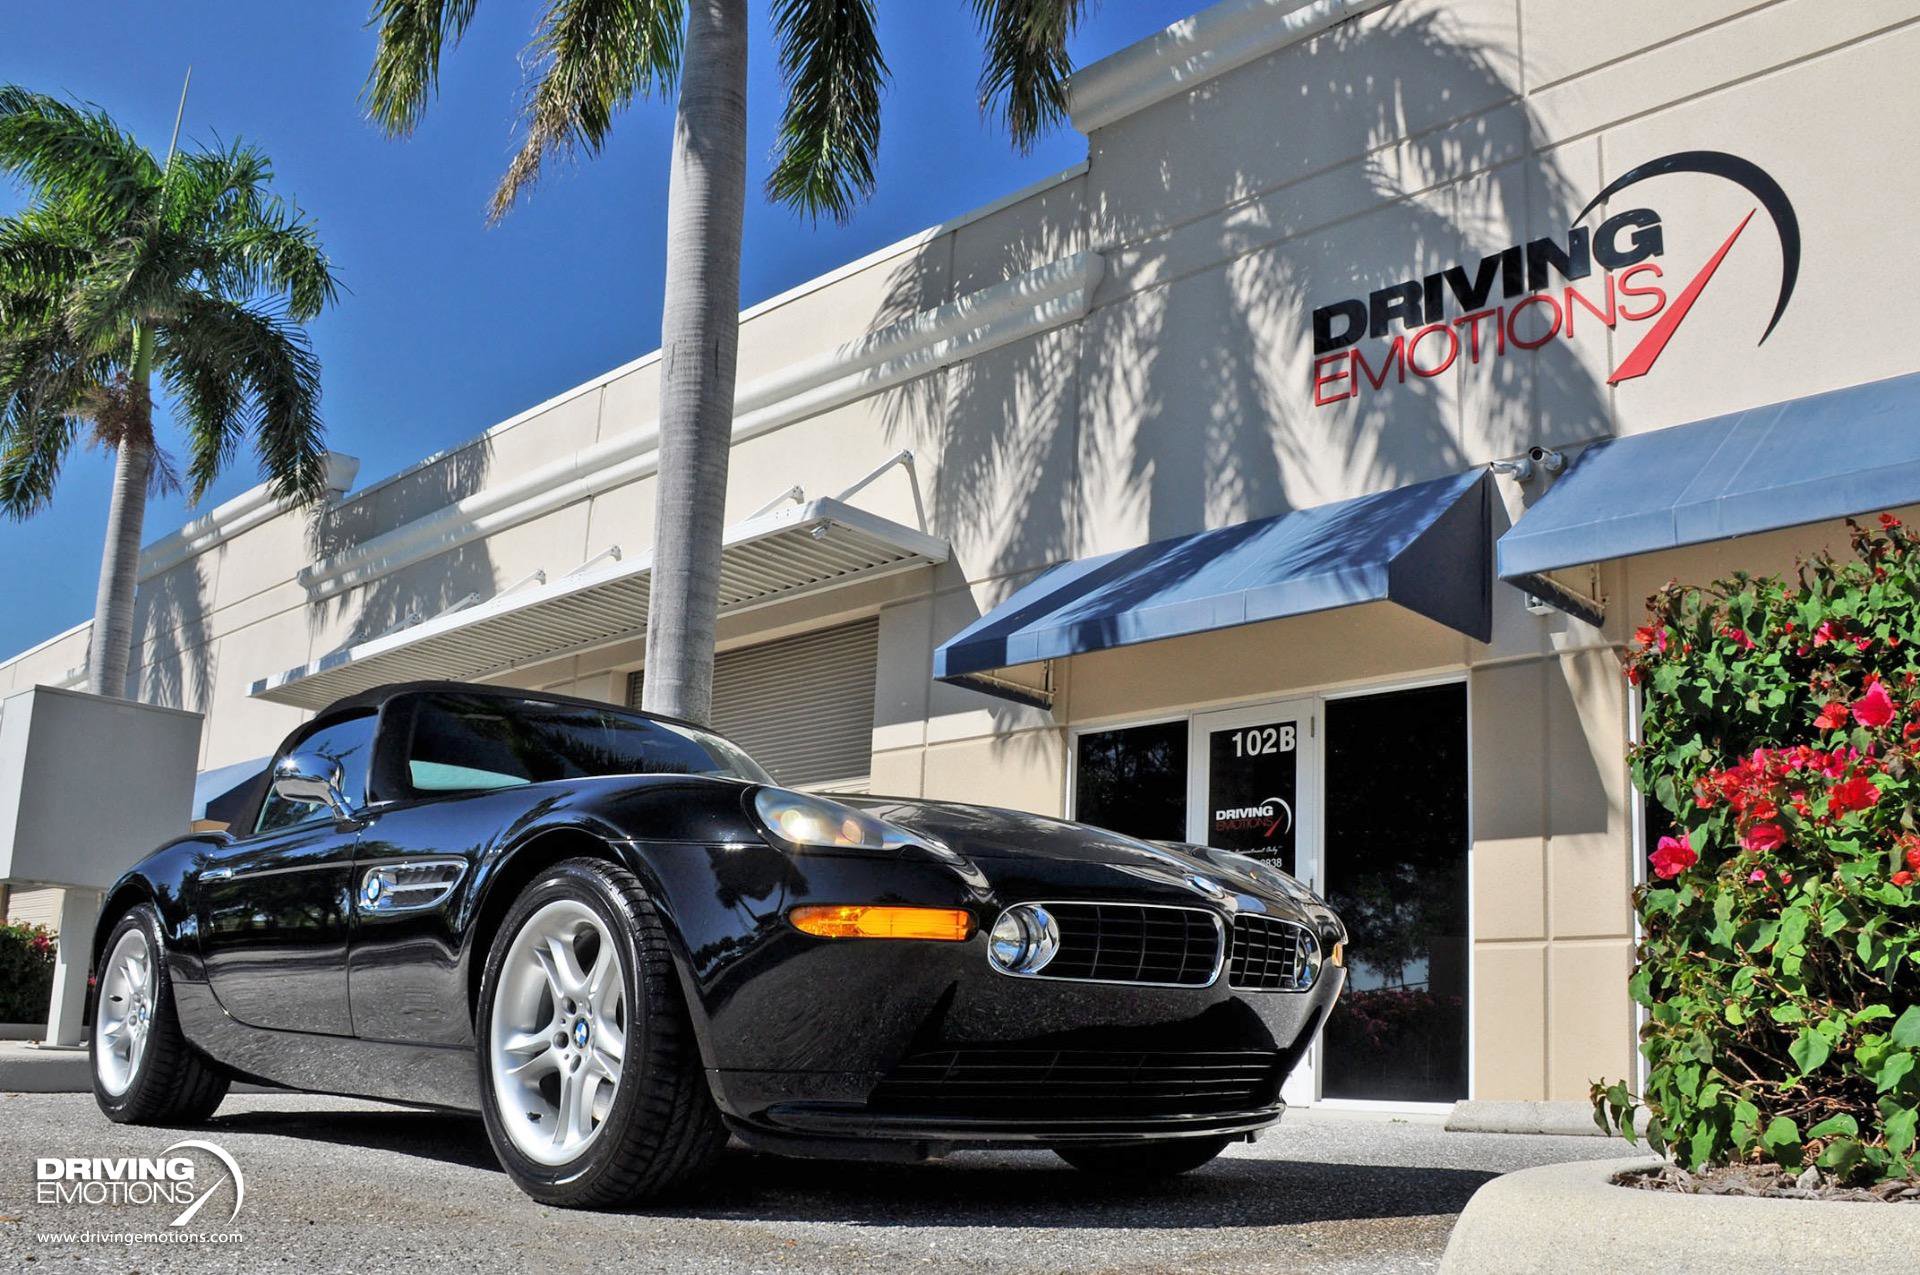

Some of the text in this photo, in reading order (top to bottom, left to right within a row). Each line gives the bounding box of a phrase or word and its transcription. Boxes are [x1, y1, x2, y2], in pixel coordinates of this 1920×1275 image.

[1313, 208, 1664, 355] DRIVING
[1314, 263, 1667, 407] EMOTIONS
[1232, 726, 1296, 757] 102B
[1216, 806, 1273, 820] DRIVING
[1216, 816, 1273, 832] EMOTIONS
